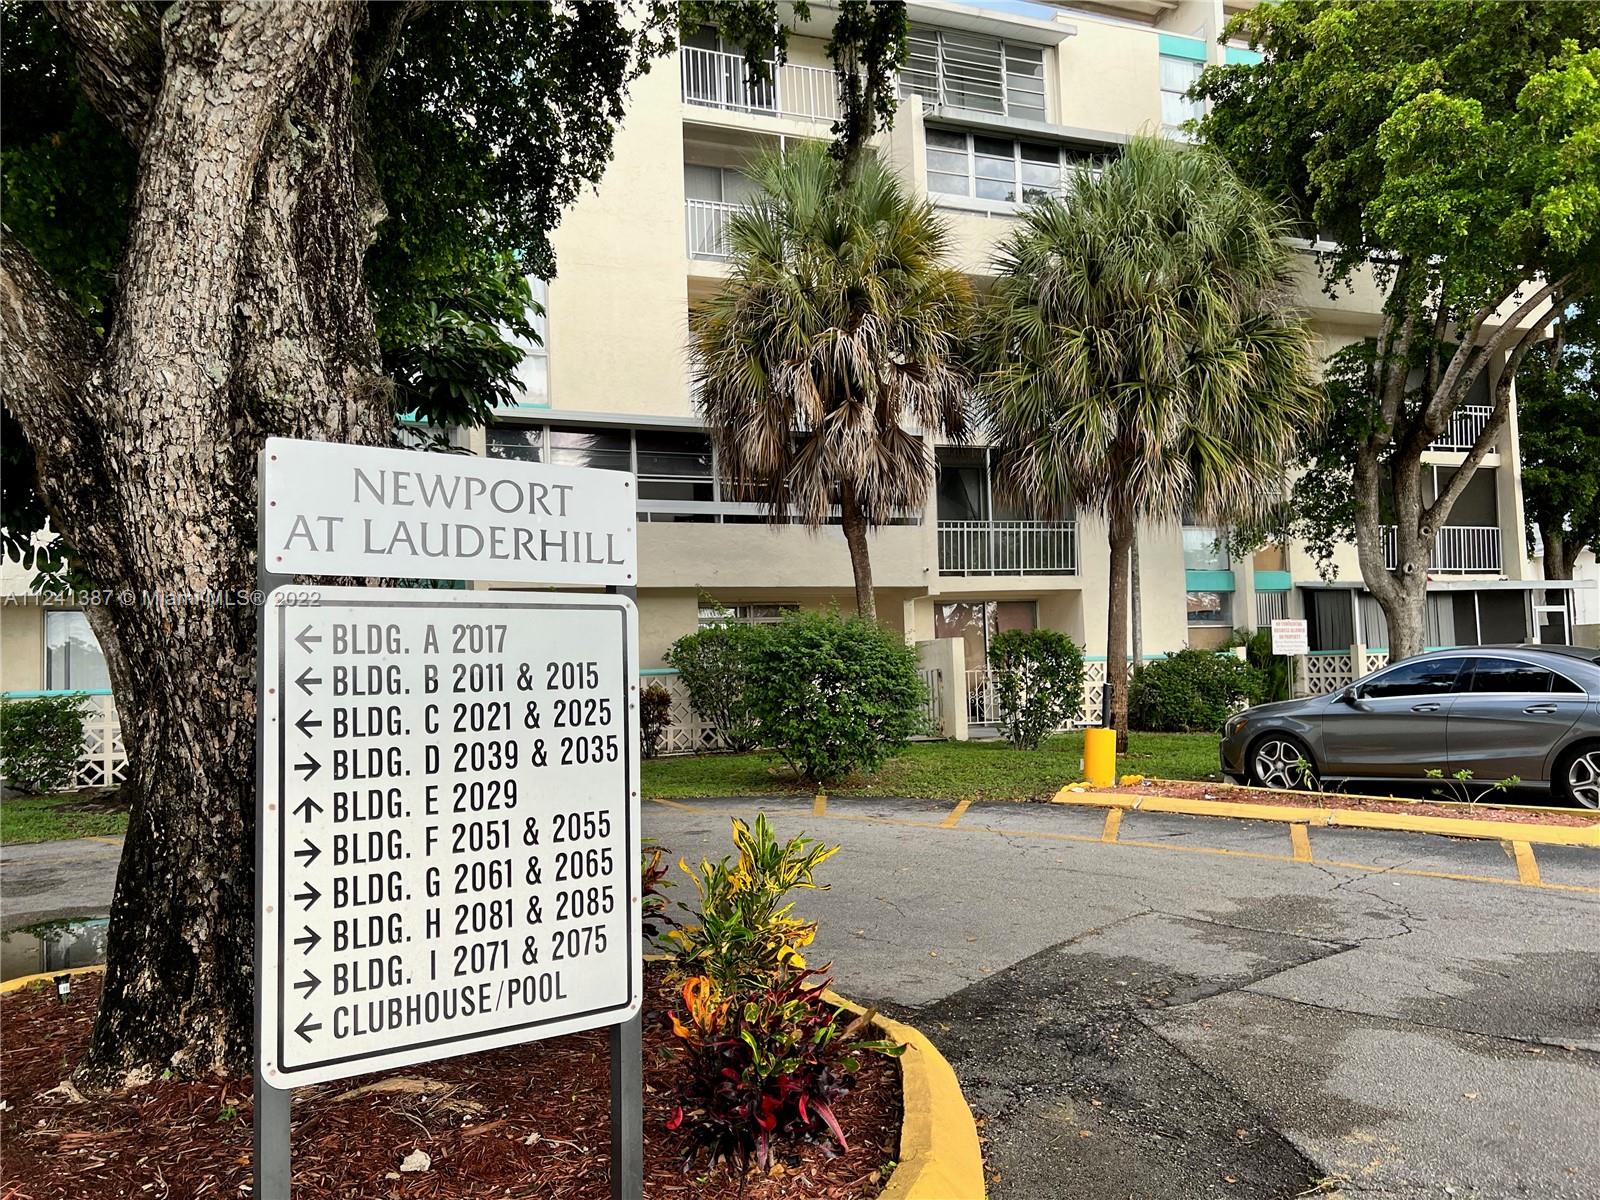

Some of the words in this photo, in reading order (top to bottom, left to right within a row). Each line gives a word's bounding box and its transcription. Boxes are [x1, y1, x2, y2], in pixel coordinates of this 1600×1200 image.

[354, 467, 574, 517] NEWPORT
[283, 514, 344, 553] AT
[363, 518, 625, 565] LAUDERHILL
[332, 623, 410, 655] BLDG.
[423, 624, 440, 654] A
[452, 623, 508, 654] 2017
[332, 664, 410, 697] BLDG.
[423, 664, 439, 695] B
[452, 663, 504, 694] 2011
[516, 662, 534, 692] &
[546, 661, 599, 691] 2015
[333, 705, 411, 740] BLDG.
[424, 703, 440, 735] C
[452, 701, 511, 734] 2021
[523, 700, 541, 730] &
[553, 697, 612, 728] 2025
[333, 746, 411, 781] BLDG.
[424, 744, 440, 775] D
[453, 739, 519, 774] 2039
[531, 738, 549, 768] &
[560, 734, 619, 766] 2035
[333, 787, 411, 824] BLDG.
[425, 784, 439, 816] E
[452, 778, 518, 814] 2029
[333, 828, 411, 867] BLDG.
[425, 825, 439, 857] F
[451, 819, 510, 855] 2051
[522, 816, 540, 847] &
[552, 809, 611, 844] 2055
[333, 870, 411, 909] BLDG.
[425, 866, 441, 898] G
[454, 858, 513, 895] 2061
[525, 855, 542, 886] &
[554, 847, 614, 883] 2065
[333, 912, 412, 953] BLDG.
[425, 907, 441, 940] H
[454, 898, 513, 936] 2081
[526, 894, 543, 926] &
[555, 884, 615, 922] 2085
[333, 954, 412, 996] BLDG.
[430, 949, 437, 981] I
[453, 939, 509, 977] 2071
[521, 935, 539, 966] &
[551, 923, 608, 962] 2075
[333, 970, 568, 1040] CLUBHOUSE/POOL
